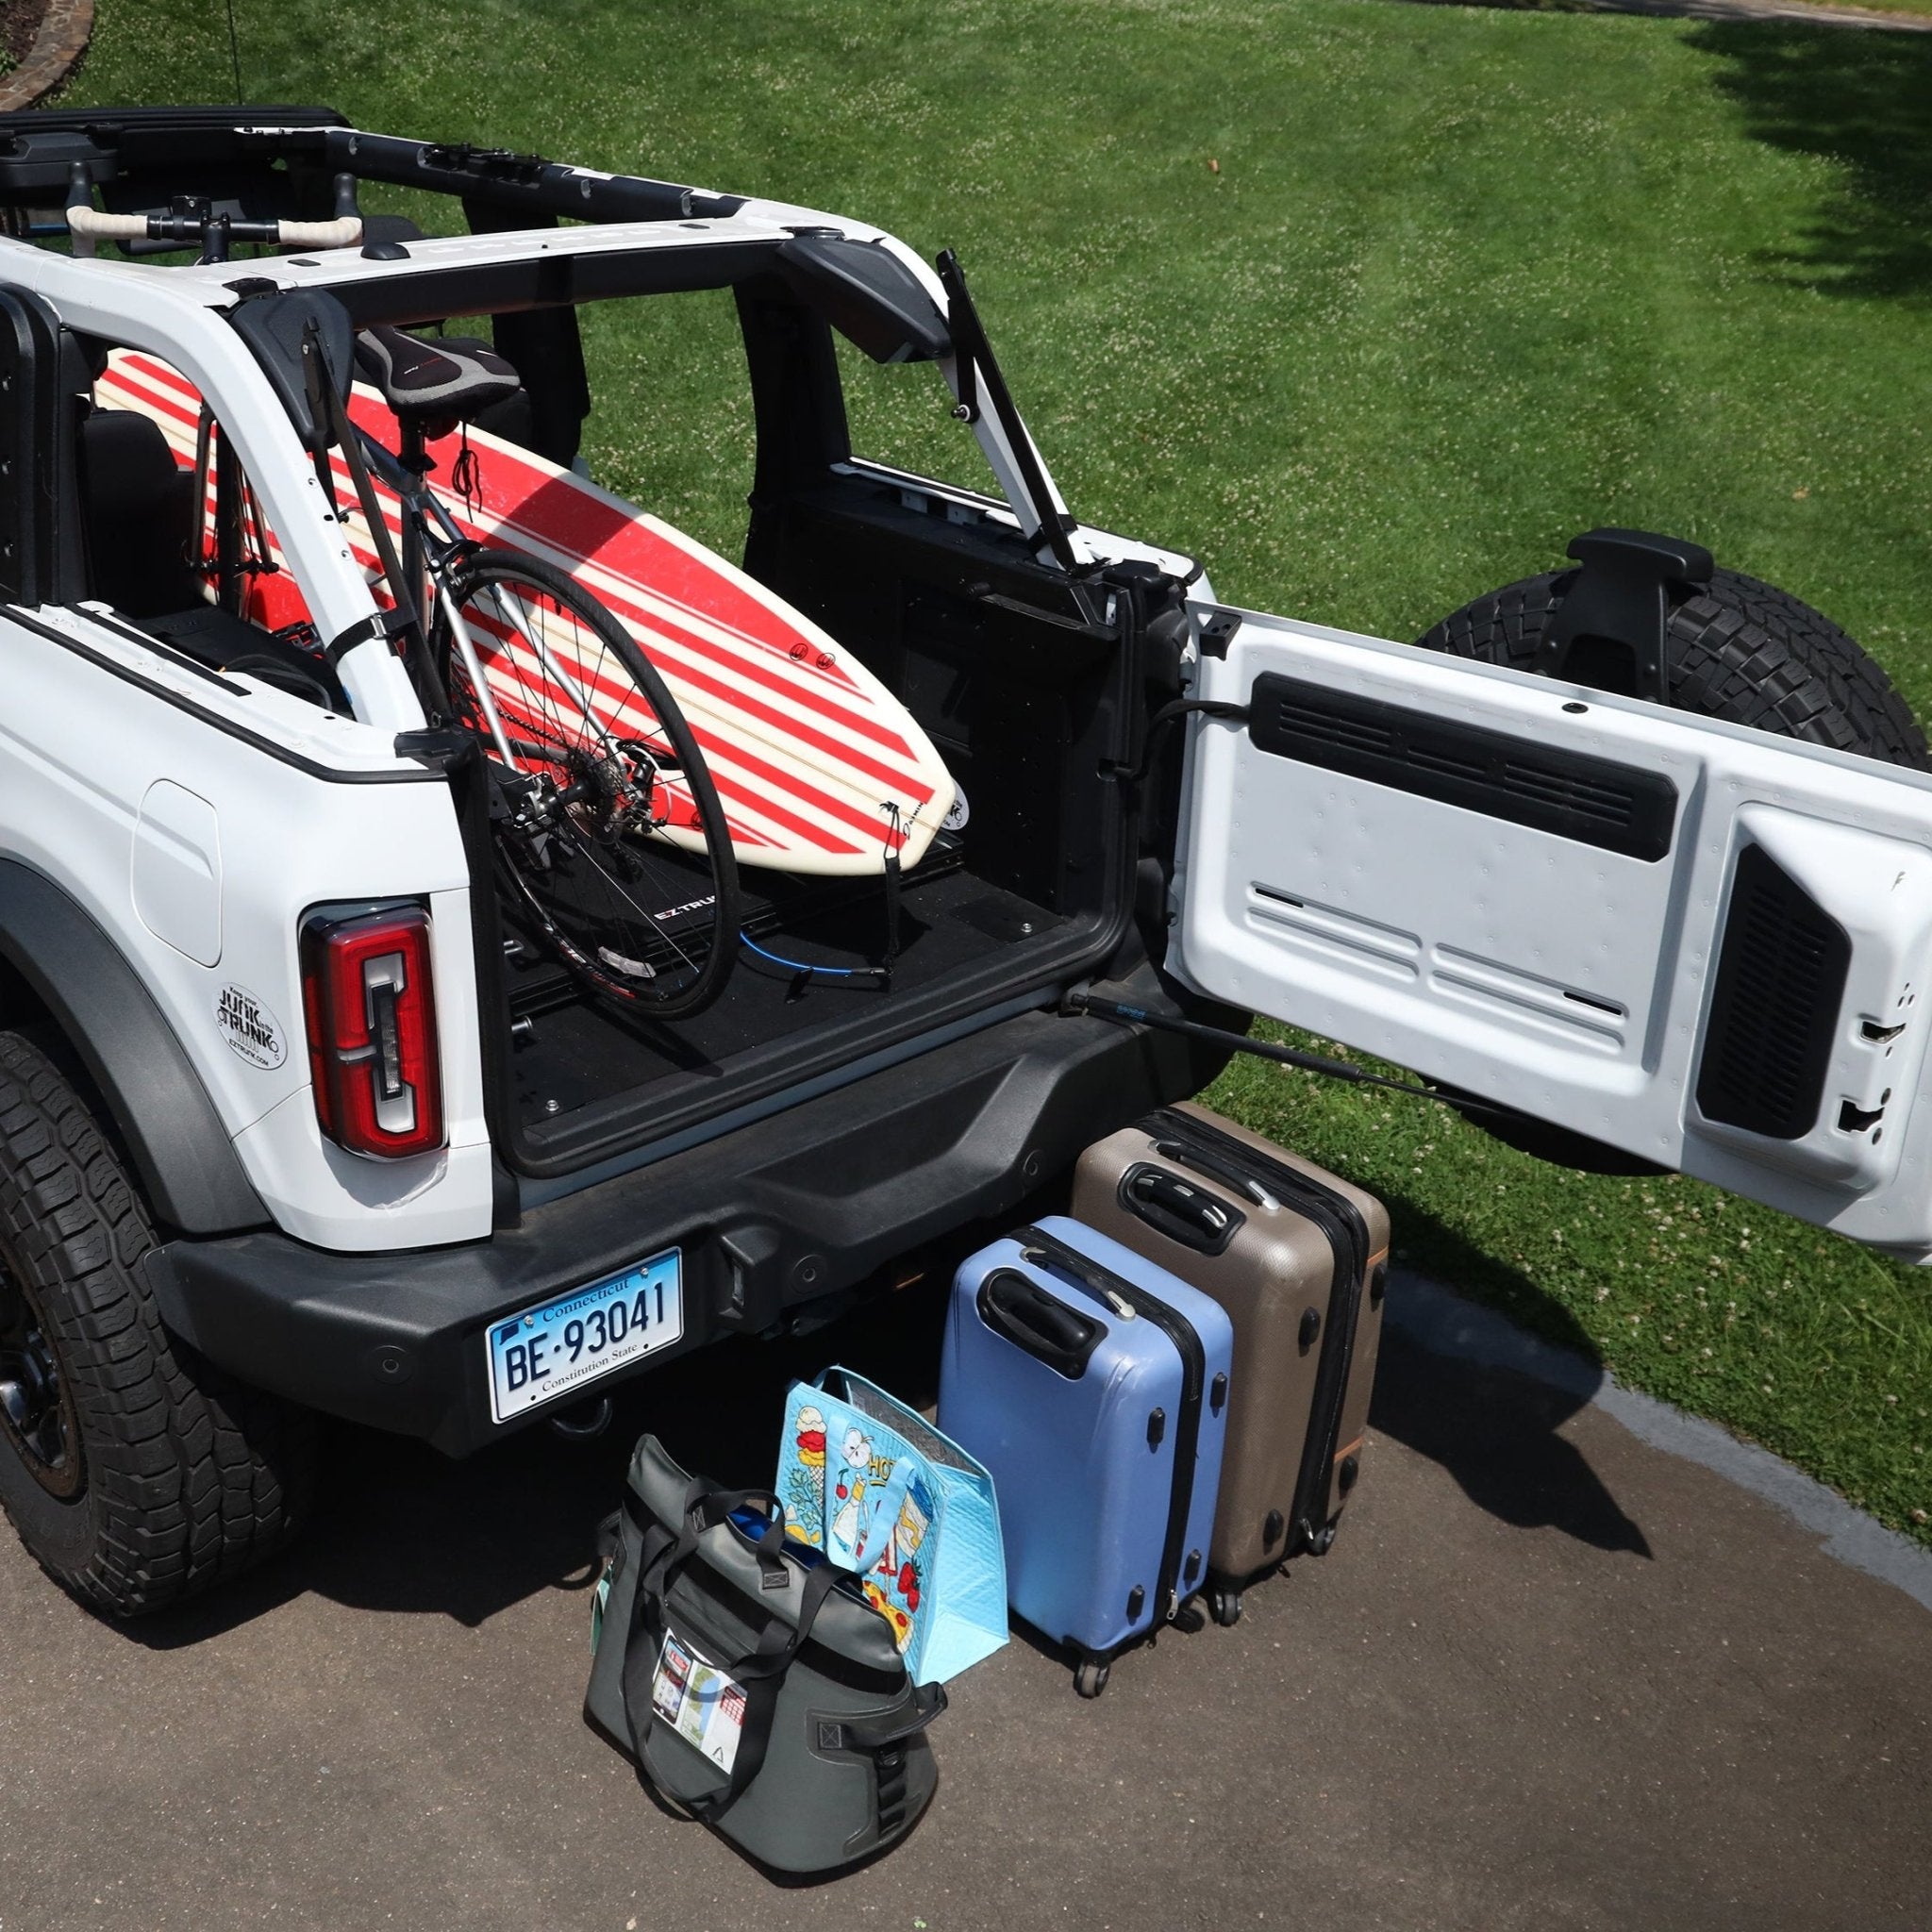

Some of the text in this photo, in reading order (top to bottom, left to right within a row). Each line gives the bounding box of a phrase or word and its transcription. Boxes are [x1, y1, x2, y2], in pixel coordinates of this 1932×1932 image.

[219, 989, 259, 1027] JUNK
[220, 1005, 273, 1051] TRUNK
[542, 1278, 630, 1323] Connecticut
[541, 1342, 639, 1392] Constitution State
